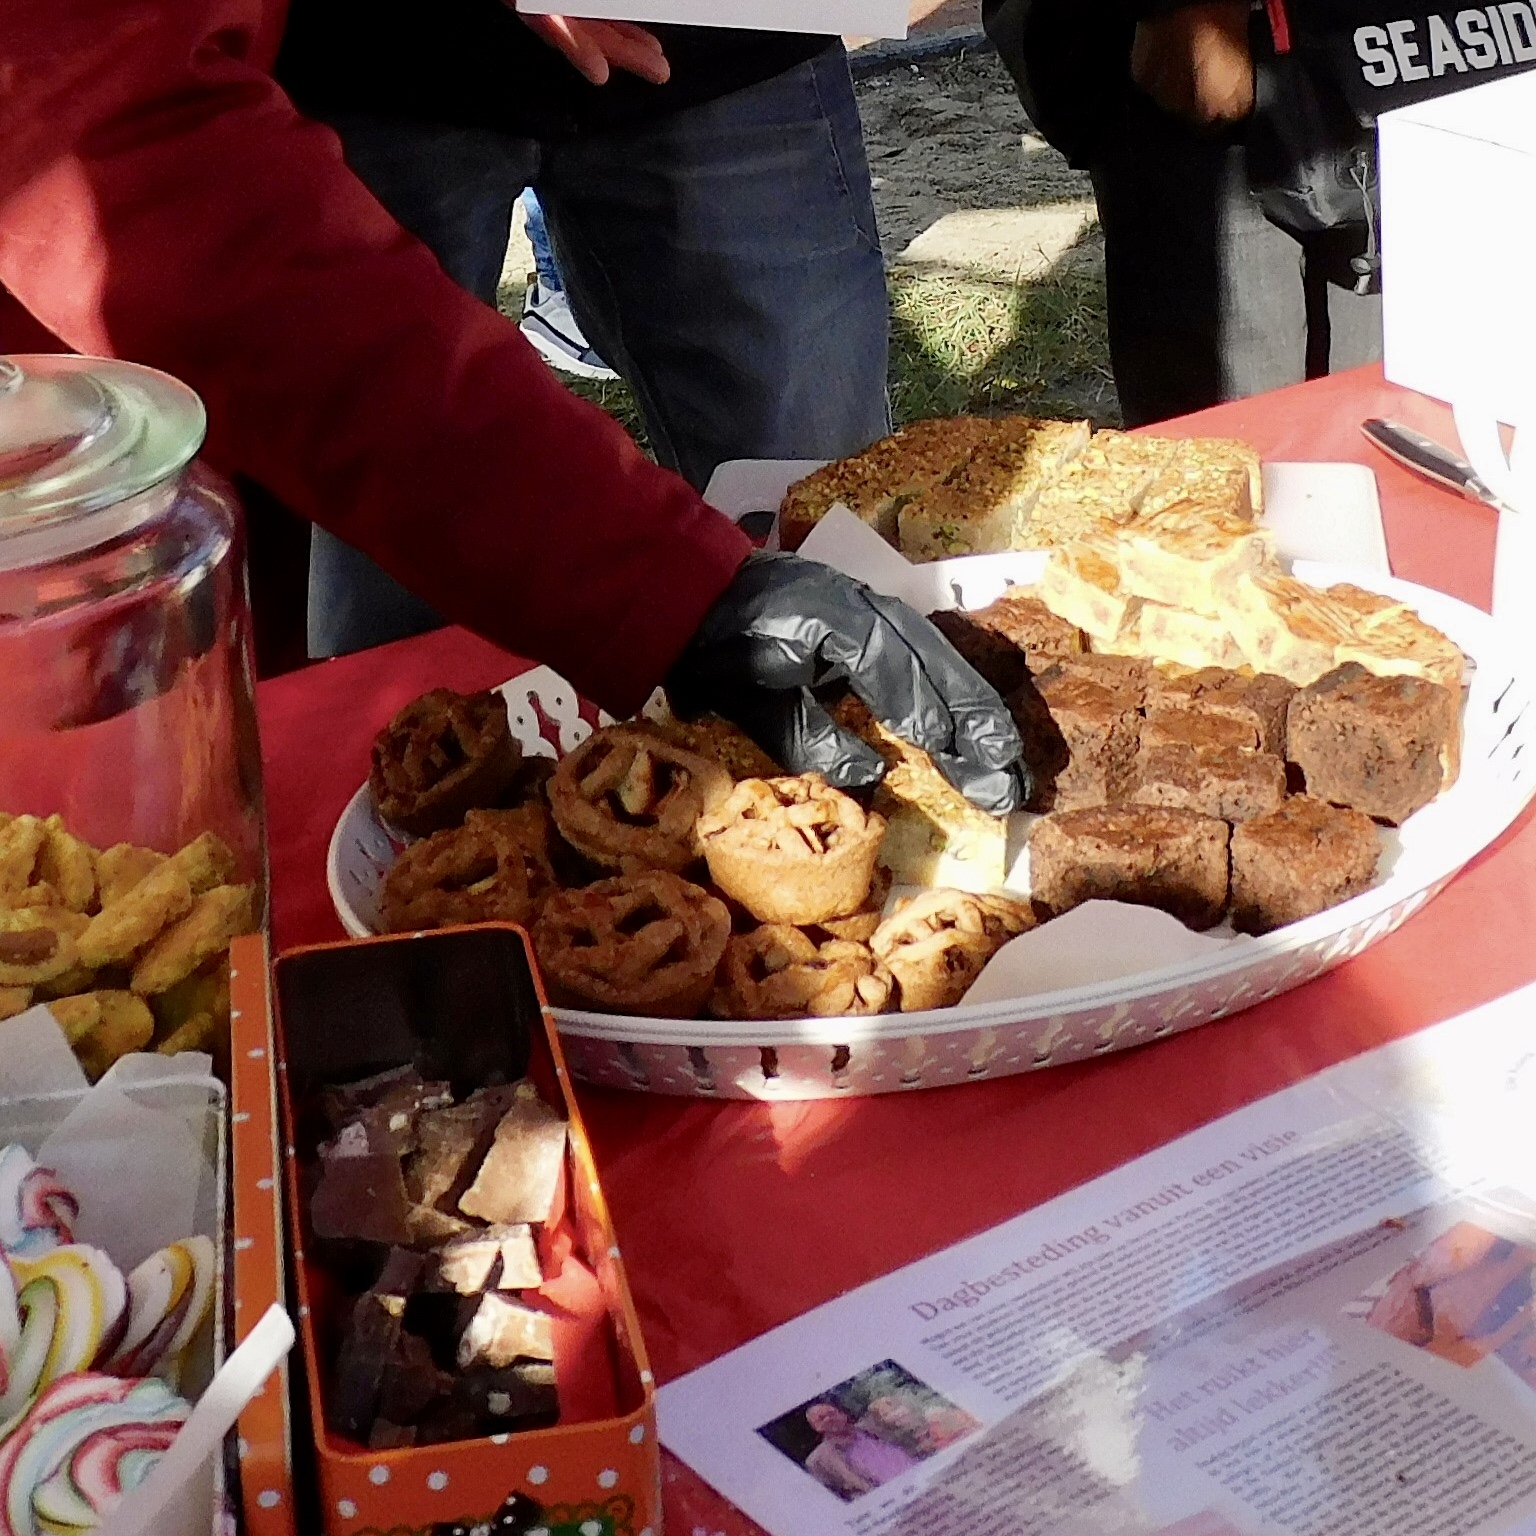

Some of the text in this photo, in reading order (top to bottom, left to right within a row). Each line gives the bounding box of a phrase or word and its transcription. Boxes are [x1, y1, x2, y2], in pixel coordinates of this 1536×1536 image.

[909, 1129, 1299, 1322] Dagbesteding vanuit een visie
